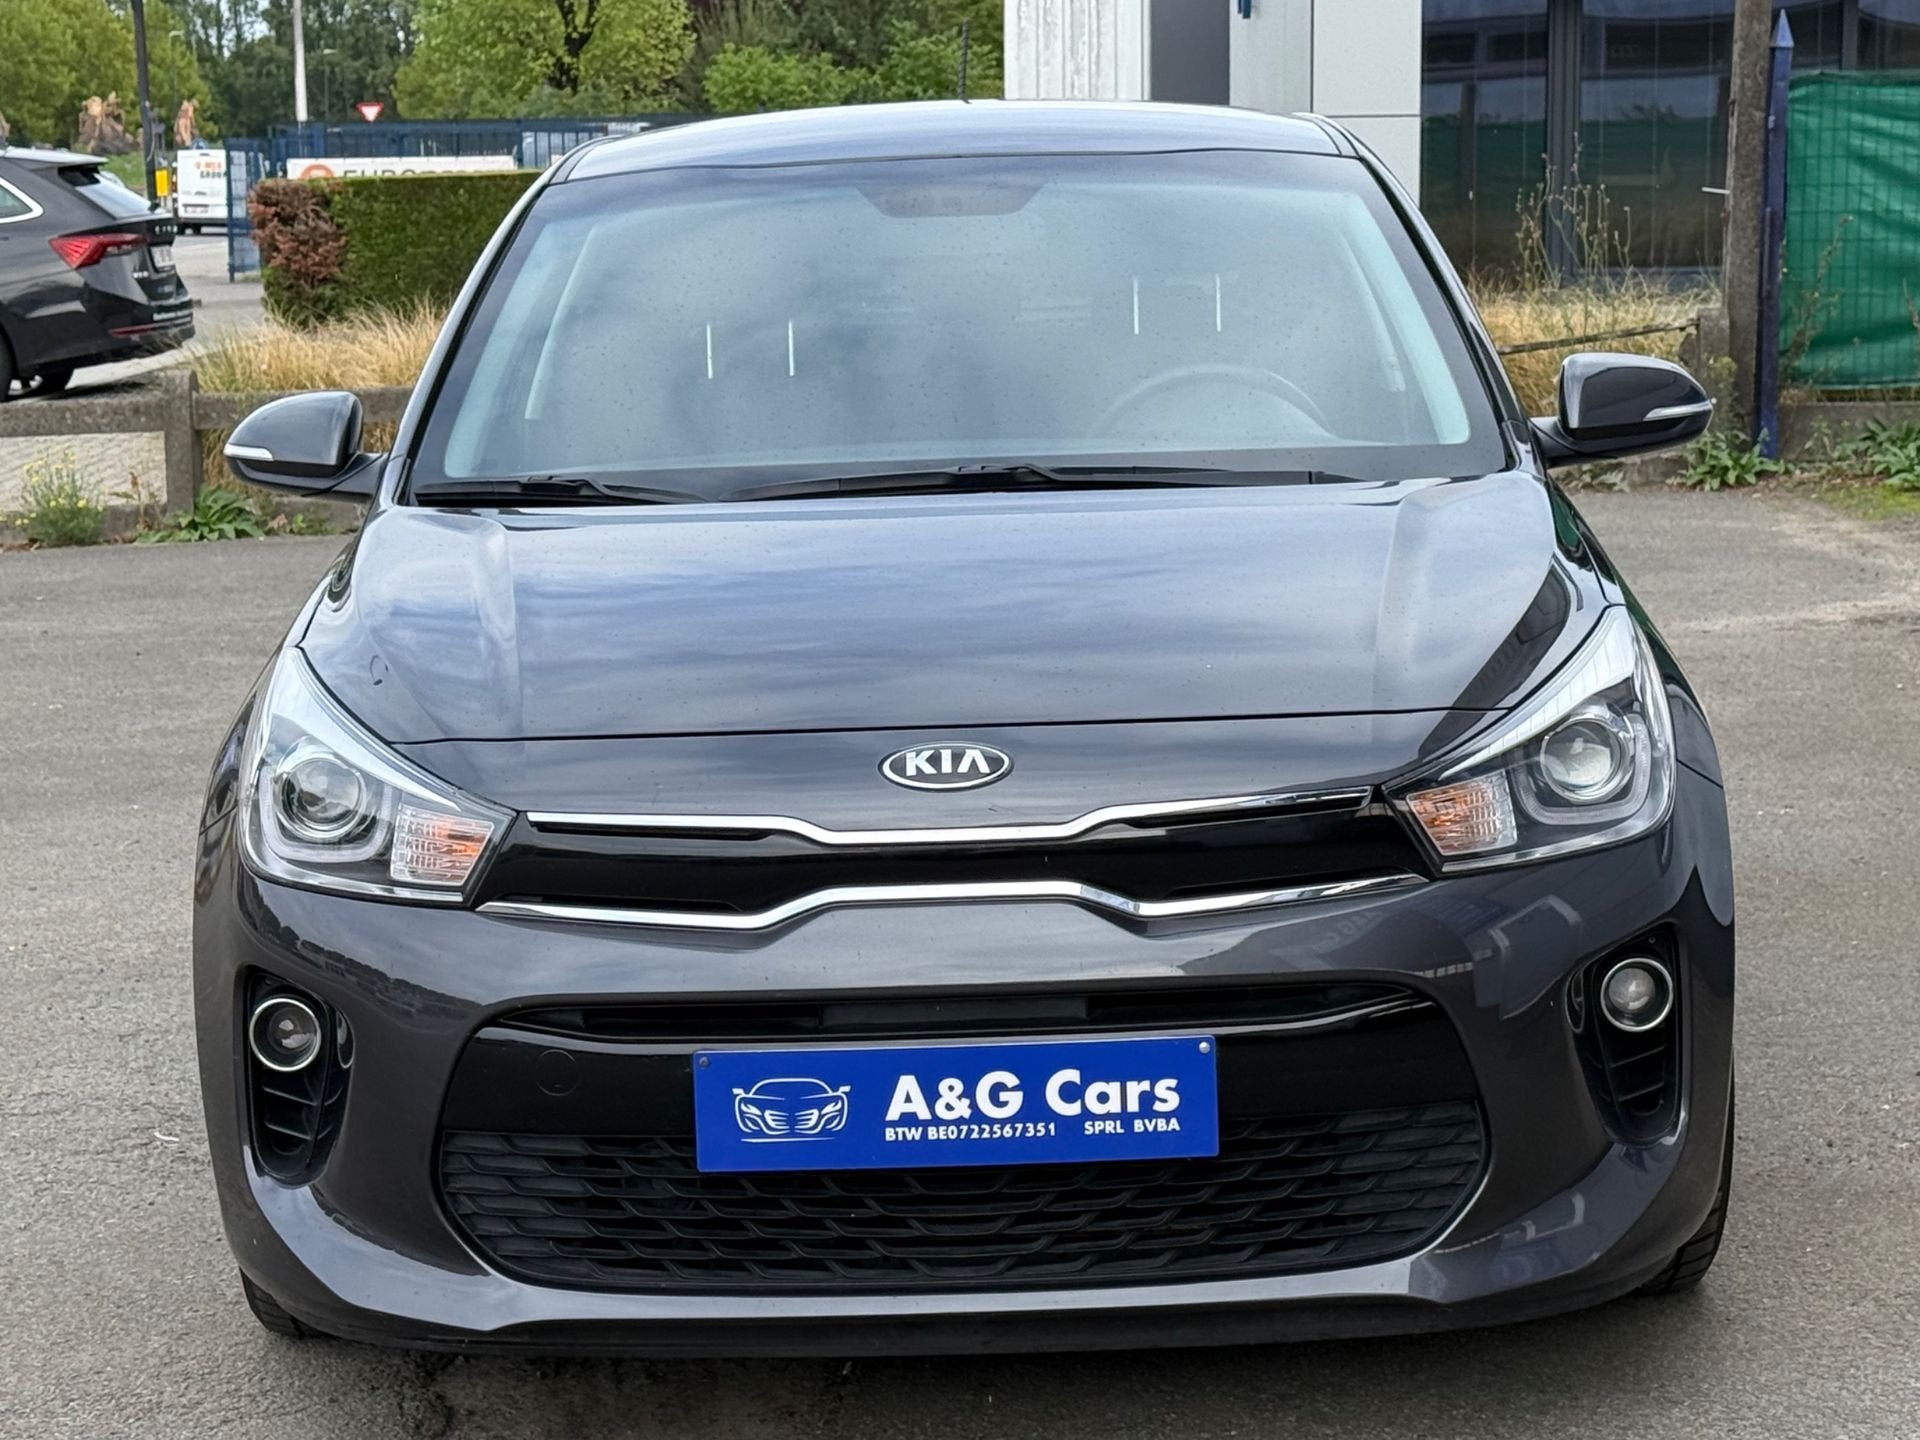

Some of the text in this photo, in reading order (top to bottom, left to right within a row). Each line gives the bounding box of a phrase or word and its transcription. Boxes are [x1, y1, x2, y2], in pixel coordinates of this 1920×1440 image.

[905, 749, 991, 777] KIA
[885, 1068, 1180, 1121] A&G Cars
[885, 1122, 1056, 1141] BTW BE0722567351
[1084, 1117, 1181, 1135] SPRL BVBA
